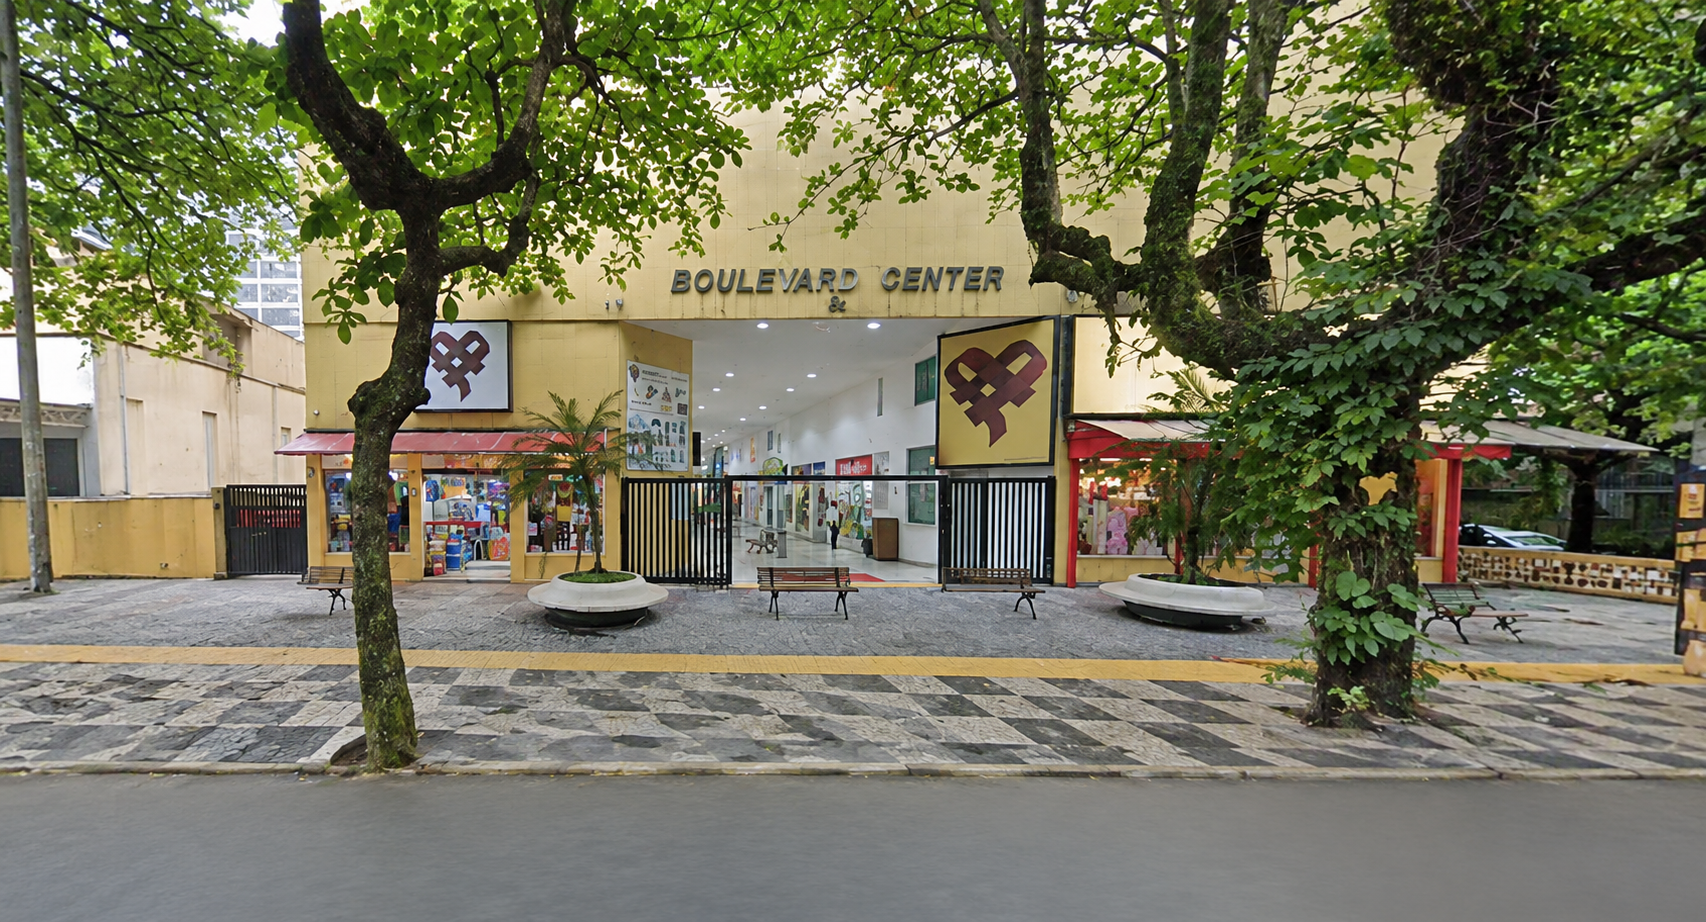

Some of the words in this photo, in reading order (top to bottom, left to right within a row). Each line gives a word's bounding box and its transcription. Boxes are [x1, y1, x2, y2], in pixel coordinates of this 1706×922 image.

[671, 268, 859, 293] BOULEVARD
[881, 266, 1004, 291] CENTER
[829, 296, 846, 313] &
